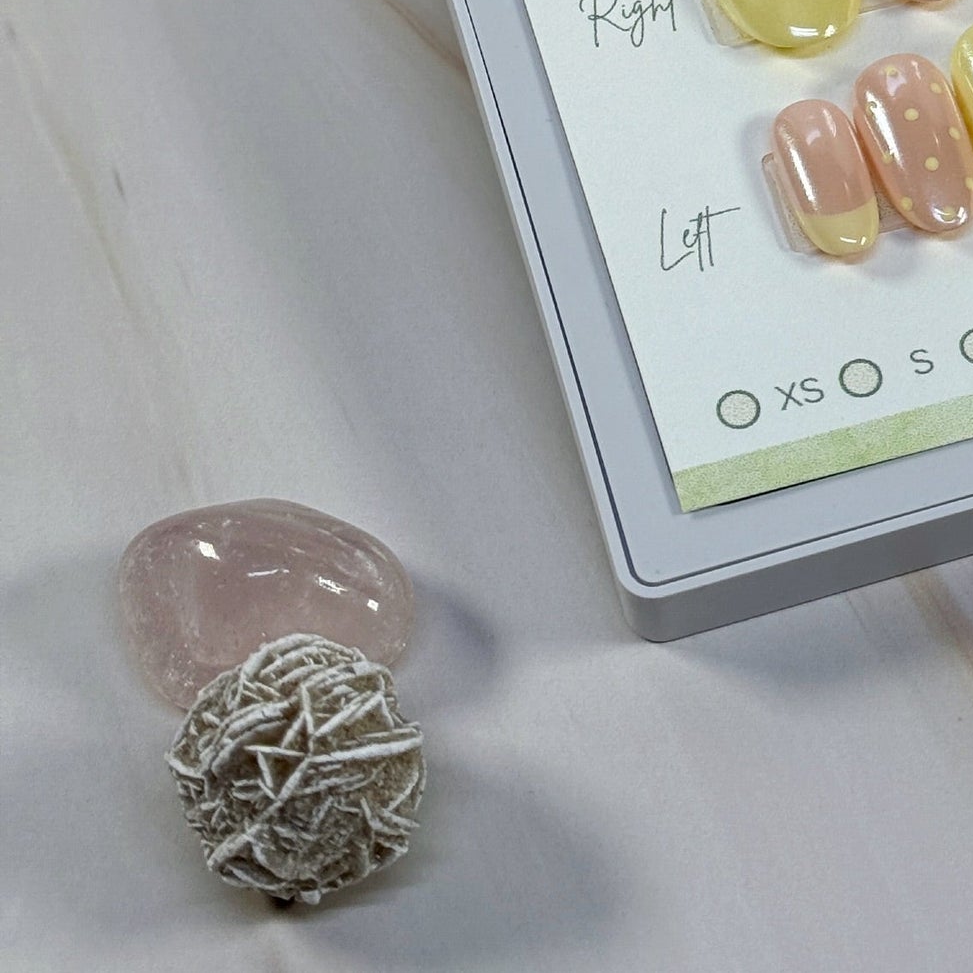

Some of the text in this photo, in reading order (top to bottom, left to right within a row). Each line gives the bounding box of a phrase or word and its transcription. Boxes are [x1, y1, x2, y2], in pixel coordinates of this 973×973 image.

[658, 206, 741, 273] Left
[774, 377, 825, 411] XS
[910, 349, 934, 374] S
